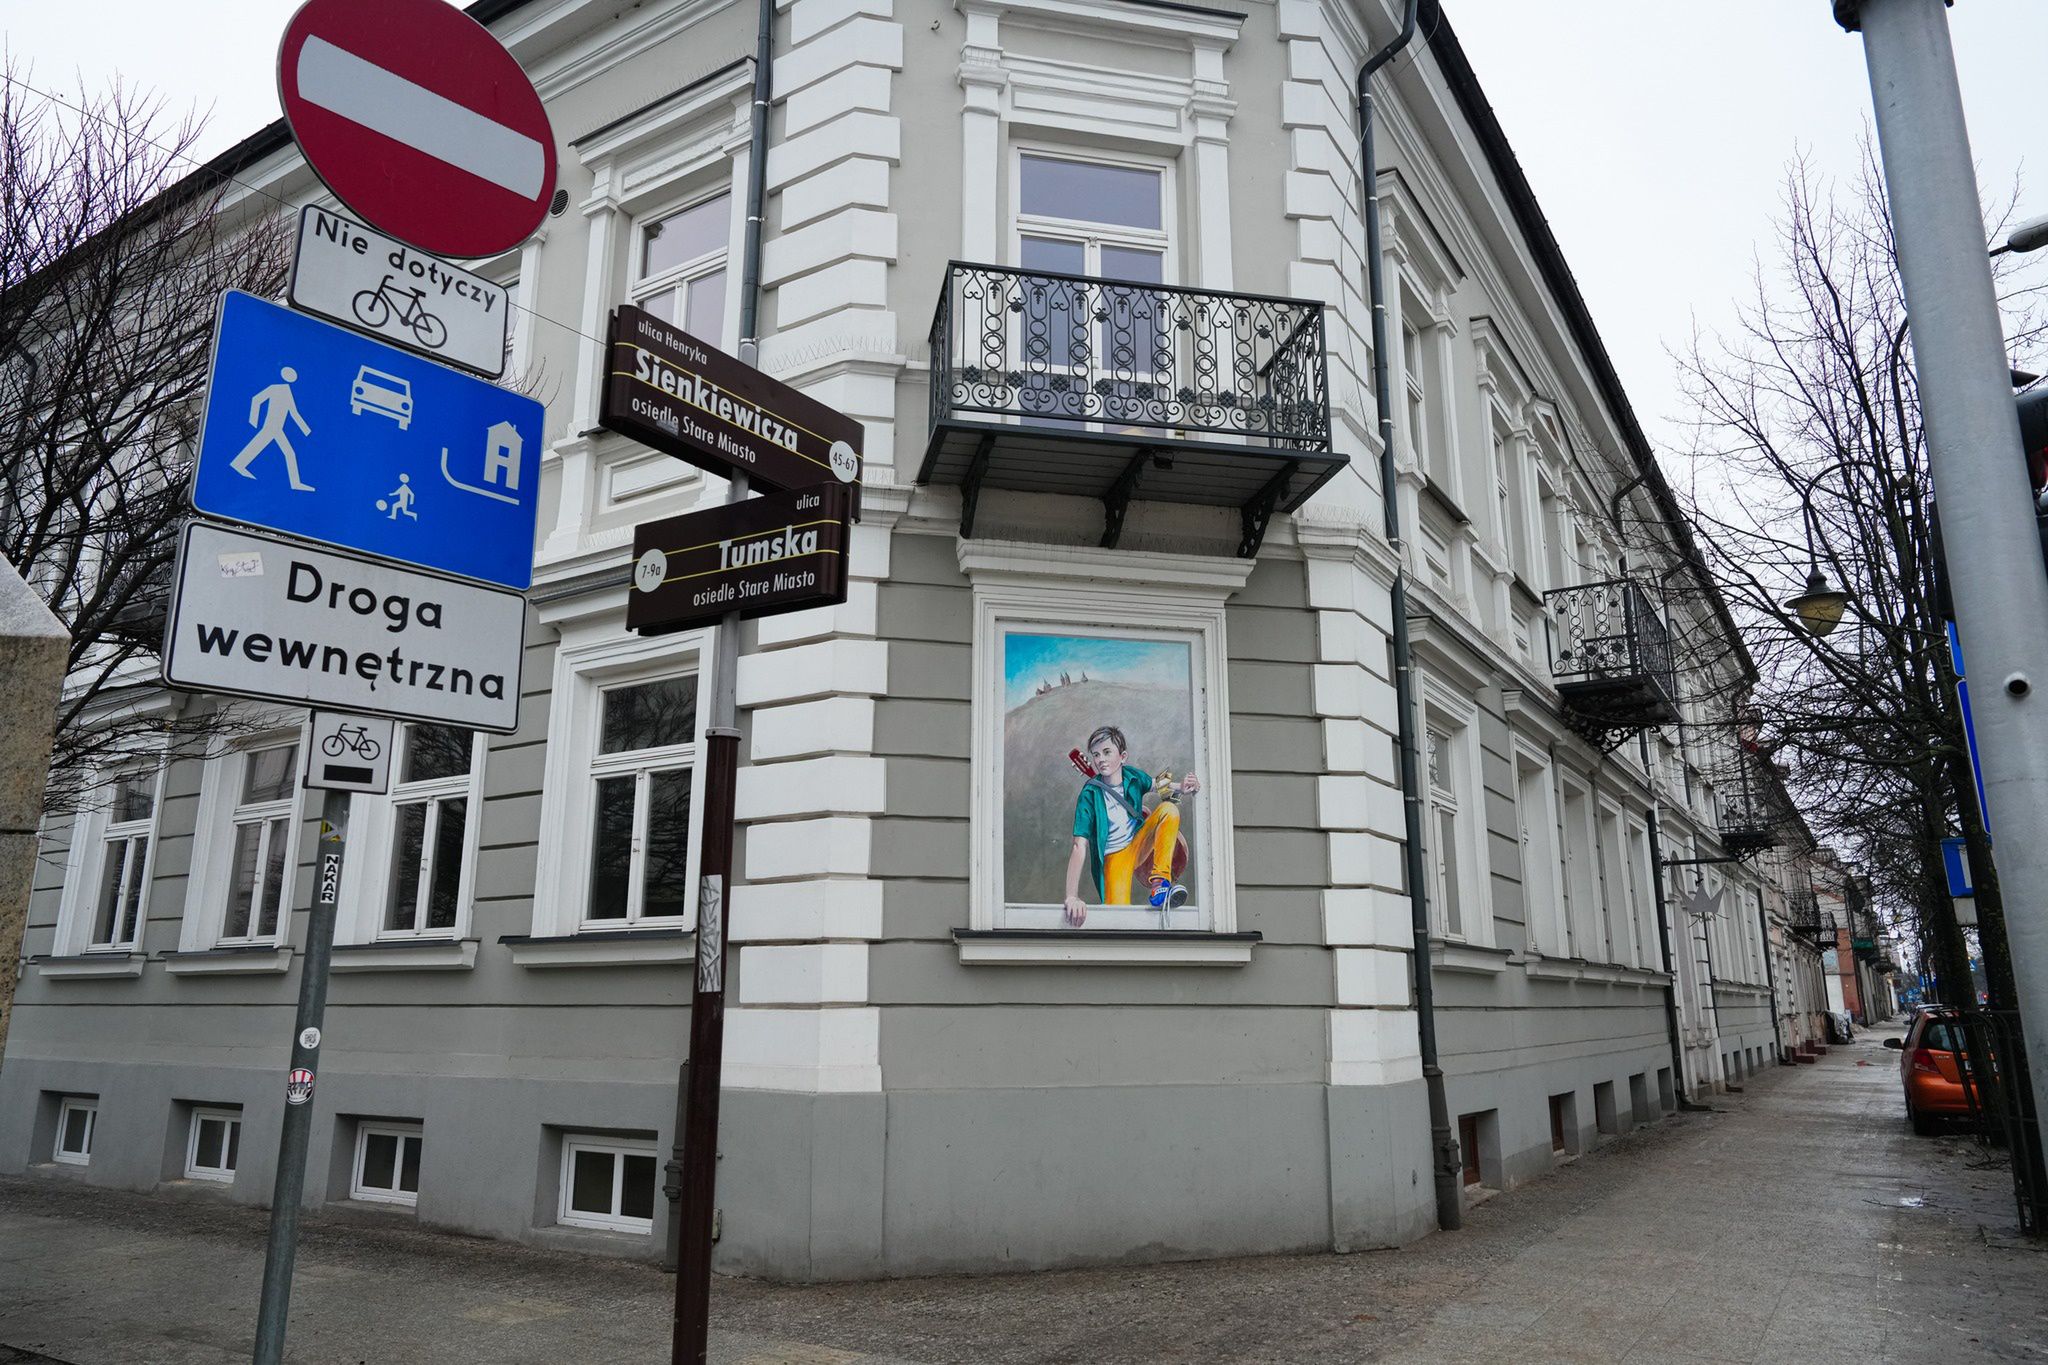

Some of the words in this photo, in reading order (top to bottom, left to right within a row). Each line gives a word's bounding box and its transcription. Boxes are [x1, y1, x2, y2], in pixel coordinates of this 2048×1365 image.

[315, 211, 369, 255] Nie
[388, 247, 496, 313] dotyczy
[638, 320, 663, 343] ulica
[665, 330, 708, 367] Henryka
[634, 348, 798, 453] Sienkiewicza
[631, 397, 679, 429] osiedle
[682, 415, 715, 445] Stare
[717, 431, 757, 464] Miasto
[831, 450, 856, 473] 45-67
[795, 494, 820, 511] ulica
[641, 563, 661, 579] 7-9a
[718, 525, 819, 571] Tumska
[286, 560, 443, 633] Droga
[693, 583, 735, 607] osiedle
[738, 579, 770, 600] Stare
[773, 571, 816, 594] Miasto
[196, 622, 505, 701] wewnętrzna
[321, 855, 339, 902] NAKAR
